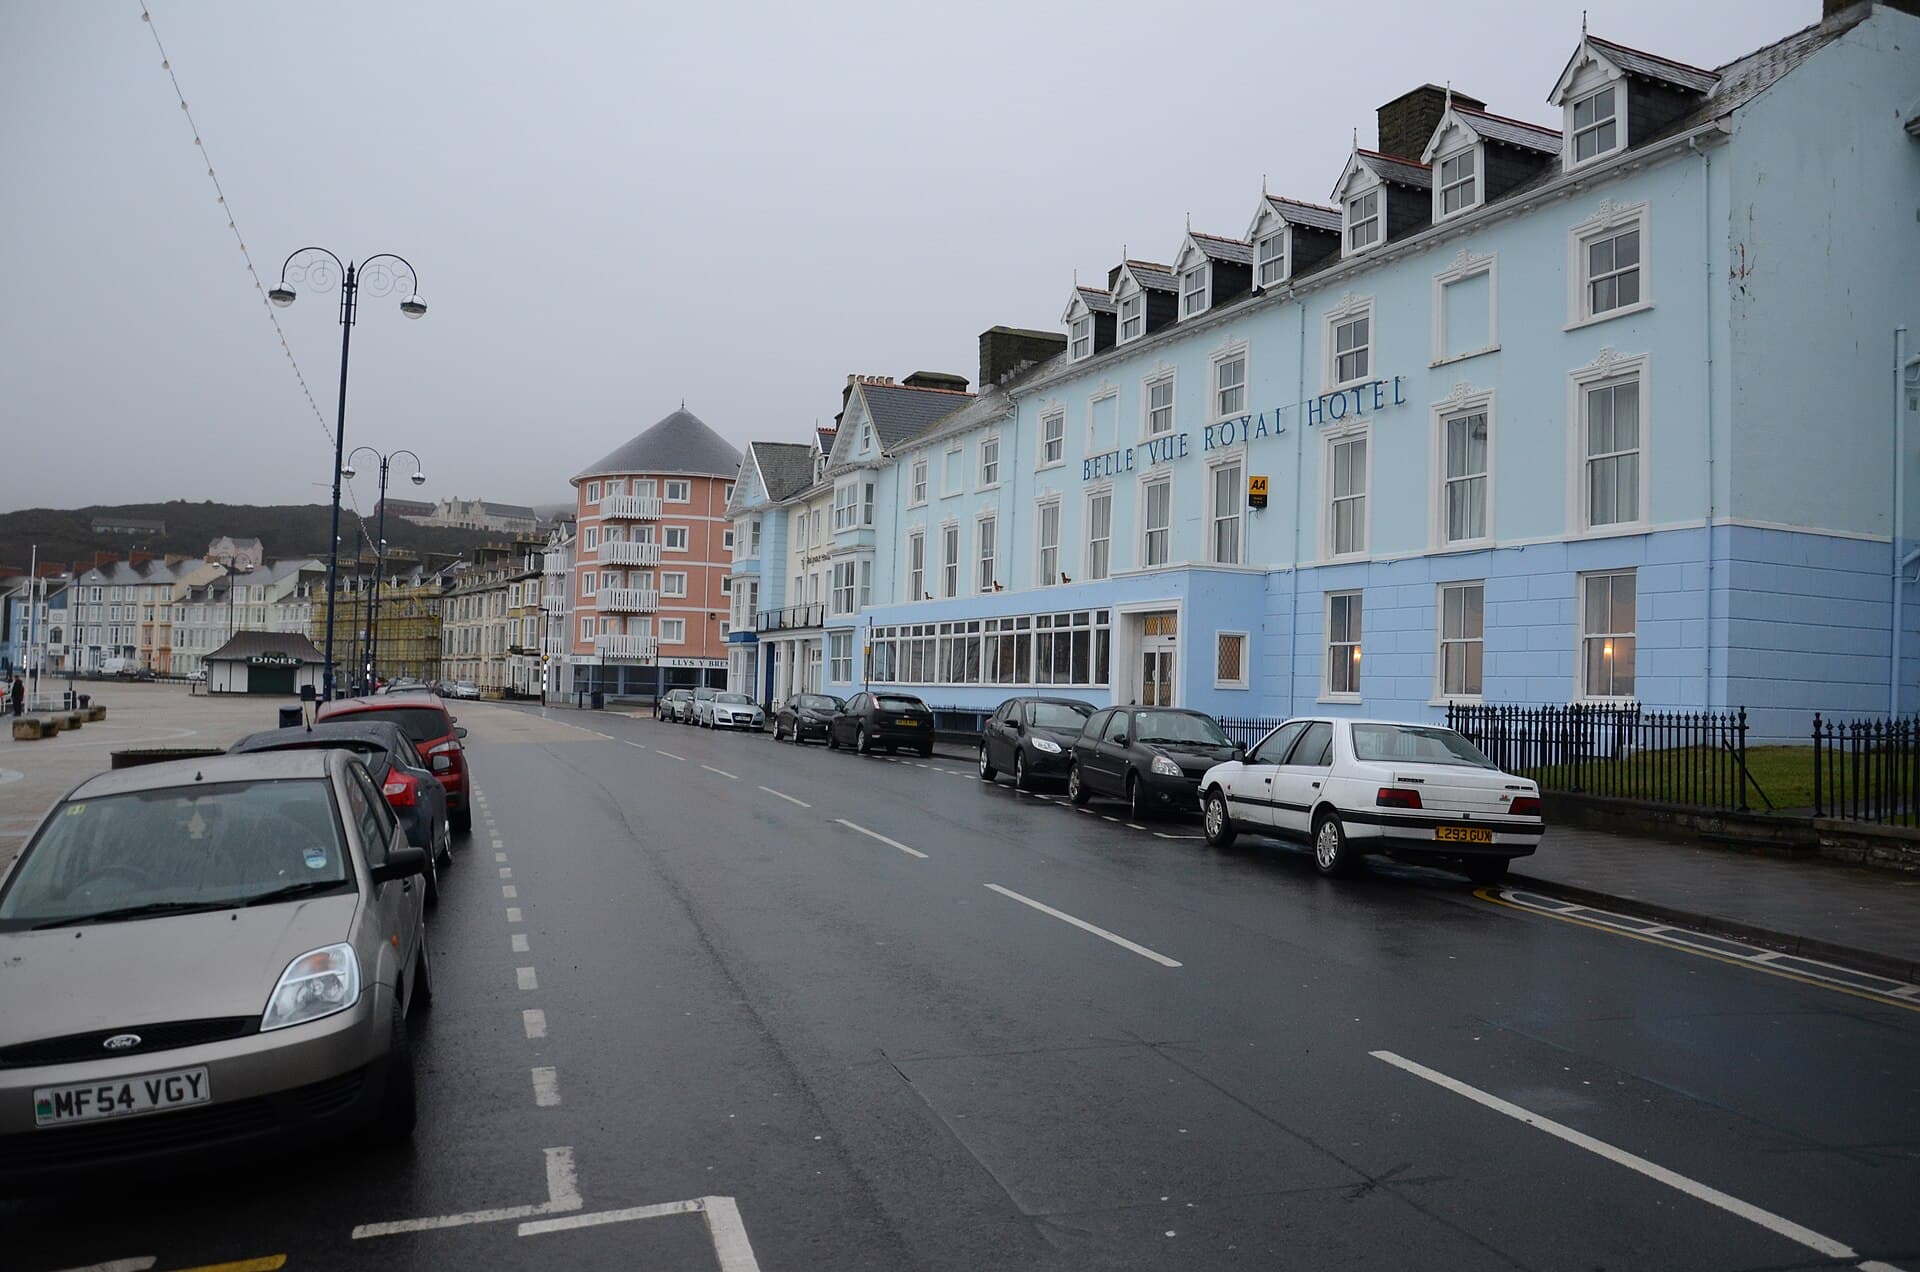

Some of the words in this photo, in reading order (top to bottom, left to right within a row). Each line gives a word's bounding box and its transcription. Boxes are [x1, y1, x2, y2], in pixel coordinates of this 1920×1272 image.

[1083, 448, 1133, 481] BELLE
[1149, 433, 1189, 465] VUE
[1204, 408, 1286, 451] ROYAL
[1308, 376, 1406, 426] HOTEL
[1251, 479, 1266, 490] AA
[252, 656, 297, 664] DINER
[1436, 827, 1467, 840] L293
[54, 1083, 135, 1118] MF54
[144, 1072, 202, 1105] VGY
